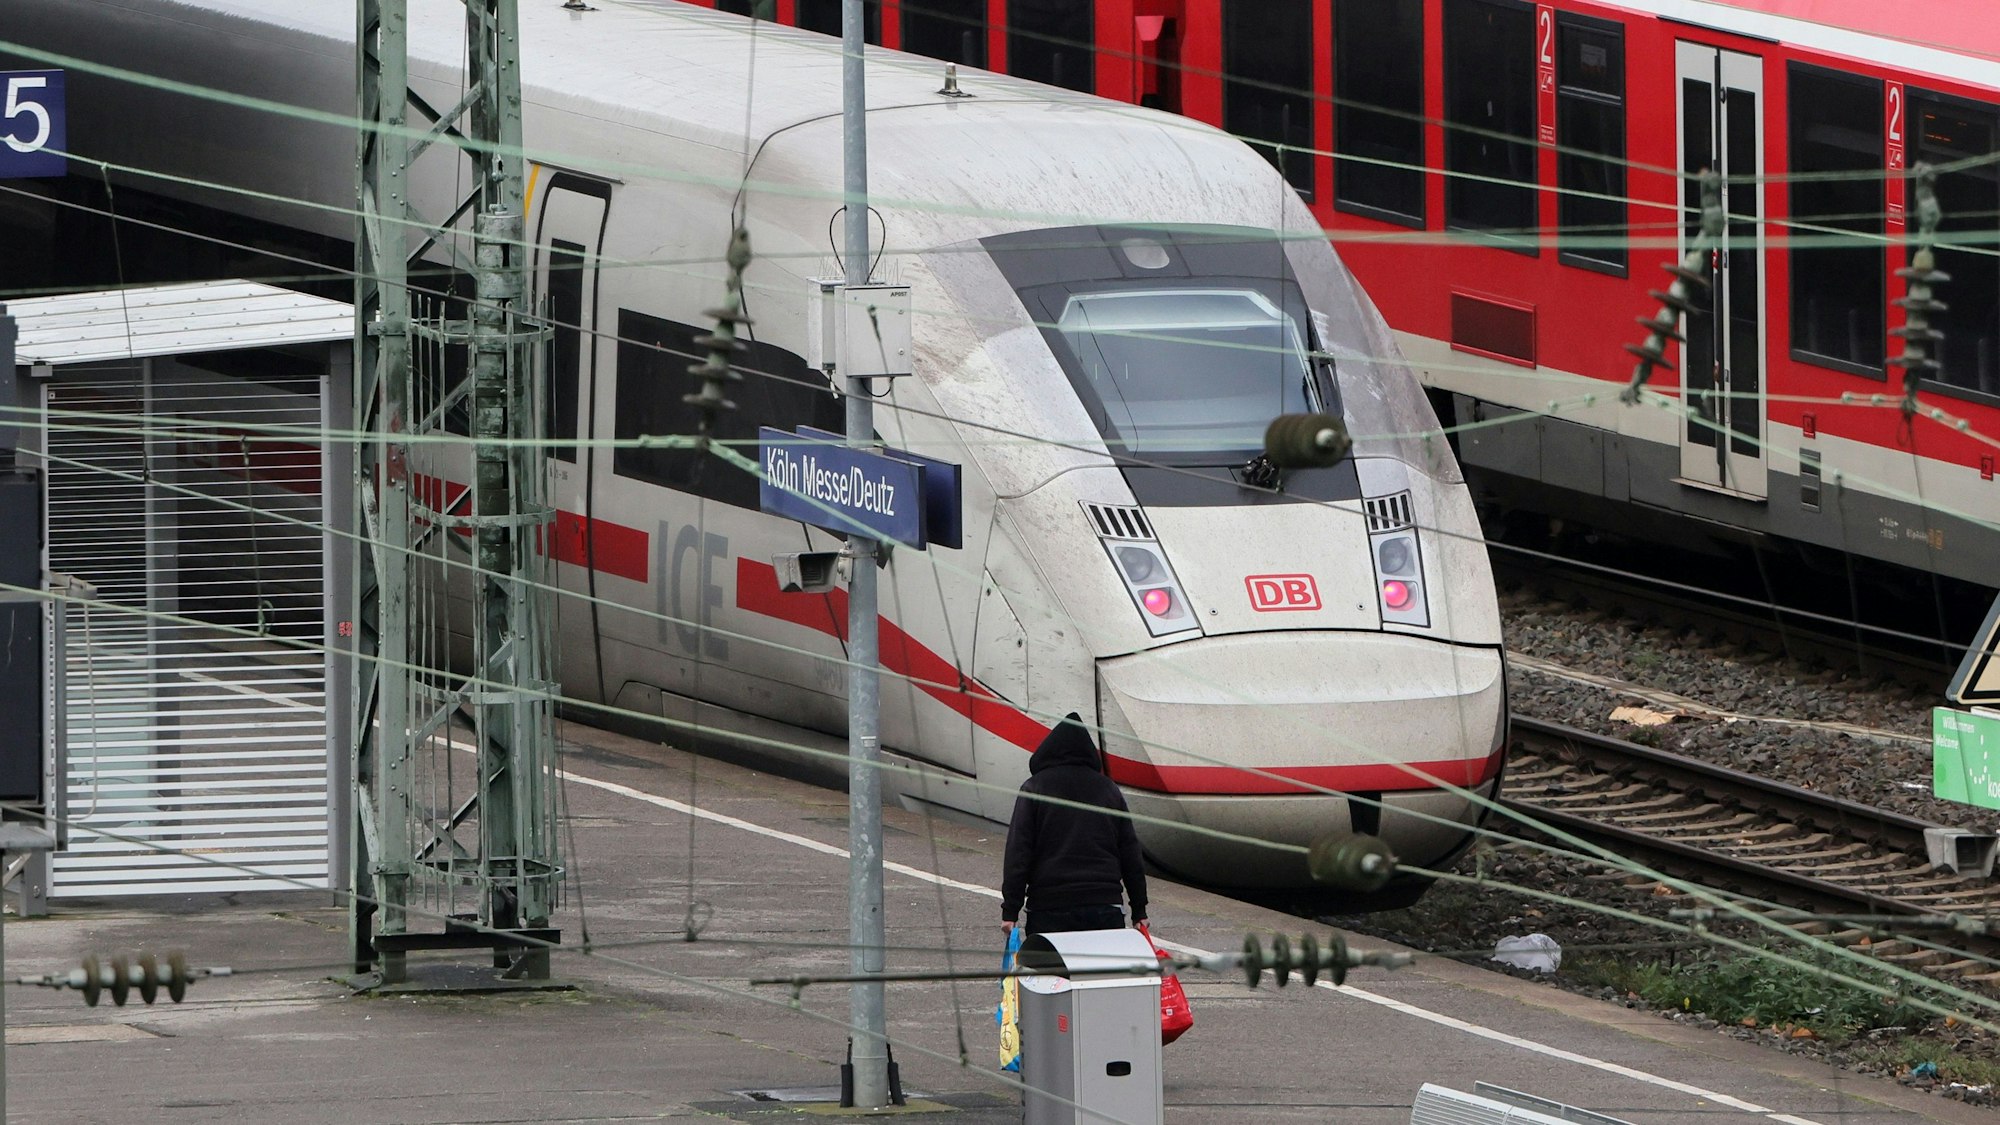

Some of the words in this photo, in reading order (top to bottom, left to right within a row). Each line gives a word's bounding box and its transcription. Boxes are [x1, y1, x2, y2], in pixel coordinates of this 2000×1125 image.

[1540, 10, 1552, 63] 2
[5, 77, 50, 153] 5
[1889, 86, 1901, 141] 2
[767, 446, 799, 493] Köln
[802, 454, 895, 517] Messe/Deutz
[657, 519, 729, 662] ICE
[1252, 579, 1313, 607] DB
